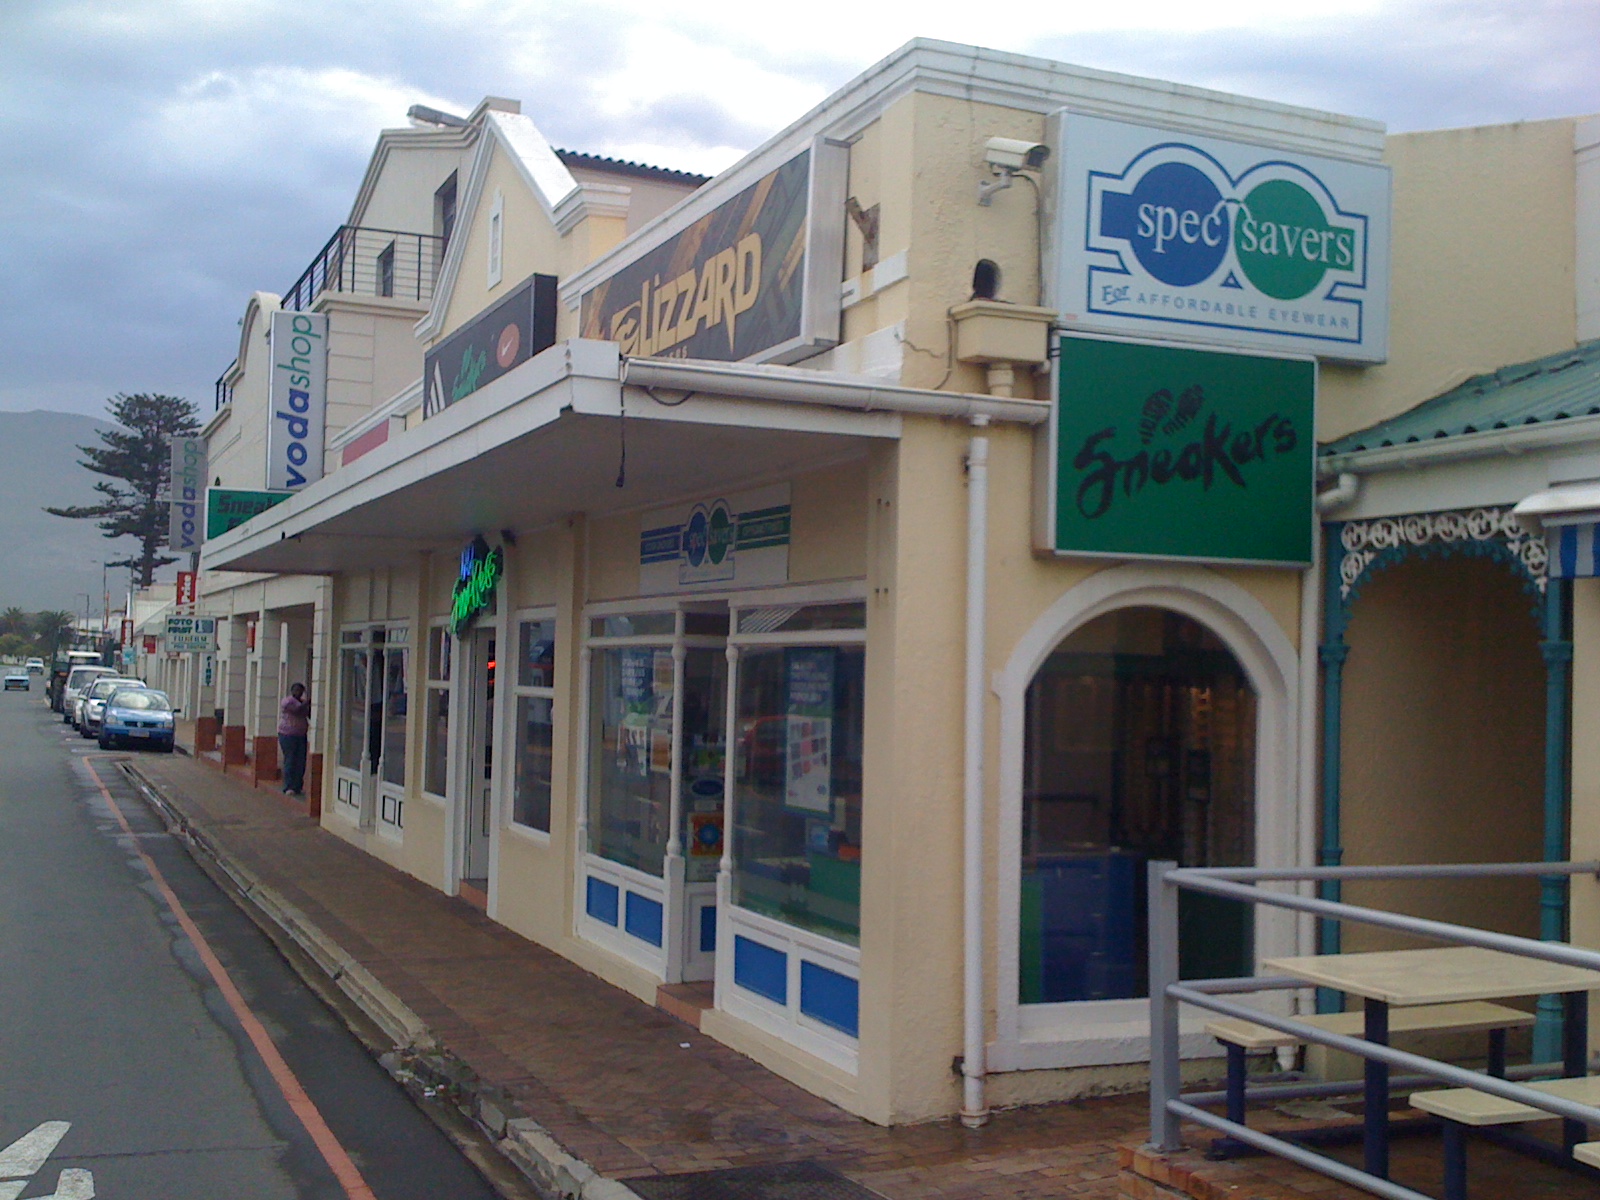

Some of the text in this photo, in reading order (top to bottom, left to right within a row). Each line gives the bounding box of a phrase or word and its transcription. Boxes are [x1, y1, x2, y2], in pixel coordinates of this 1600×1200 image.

[1137, 202, 1351, 267] spec savers
[1101, 285, 1350, 329] For AFFORDABLE EYEWEAR
[276, 314, 321, 488] vodashop
[173, 440, 206, 549] vodashop
